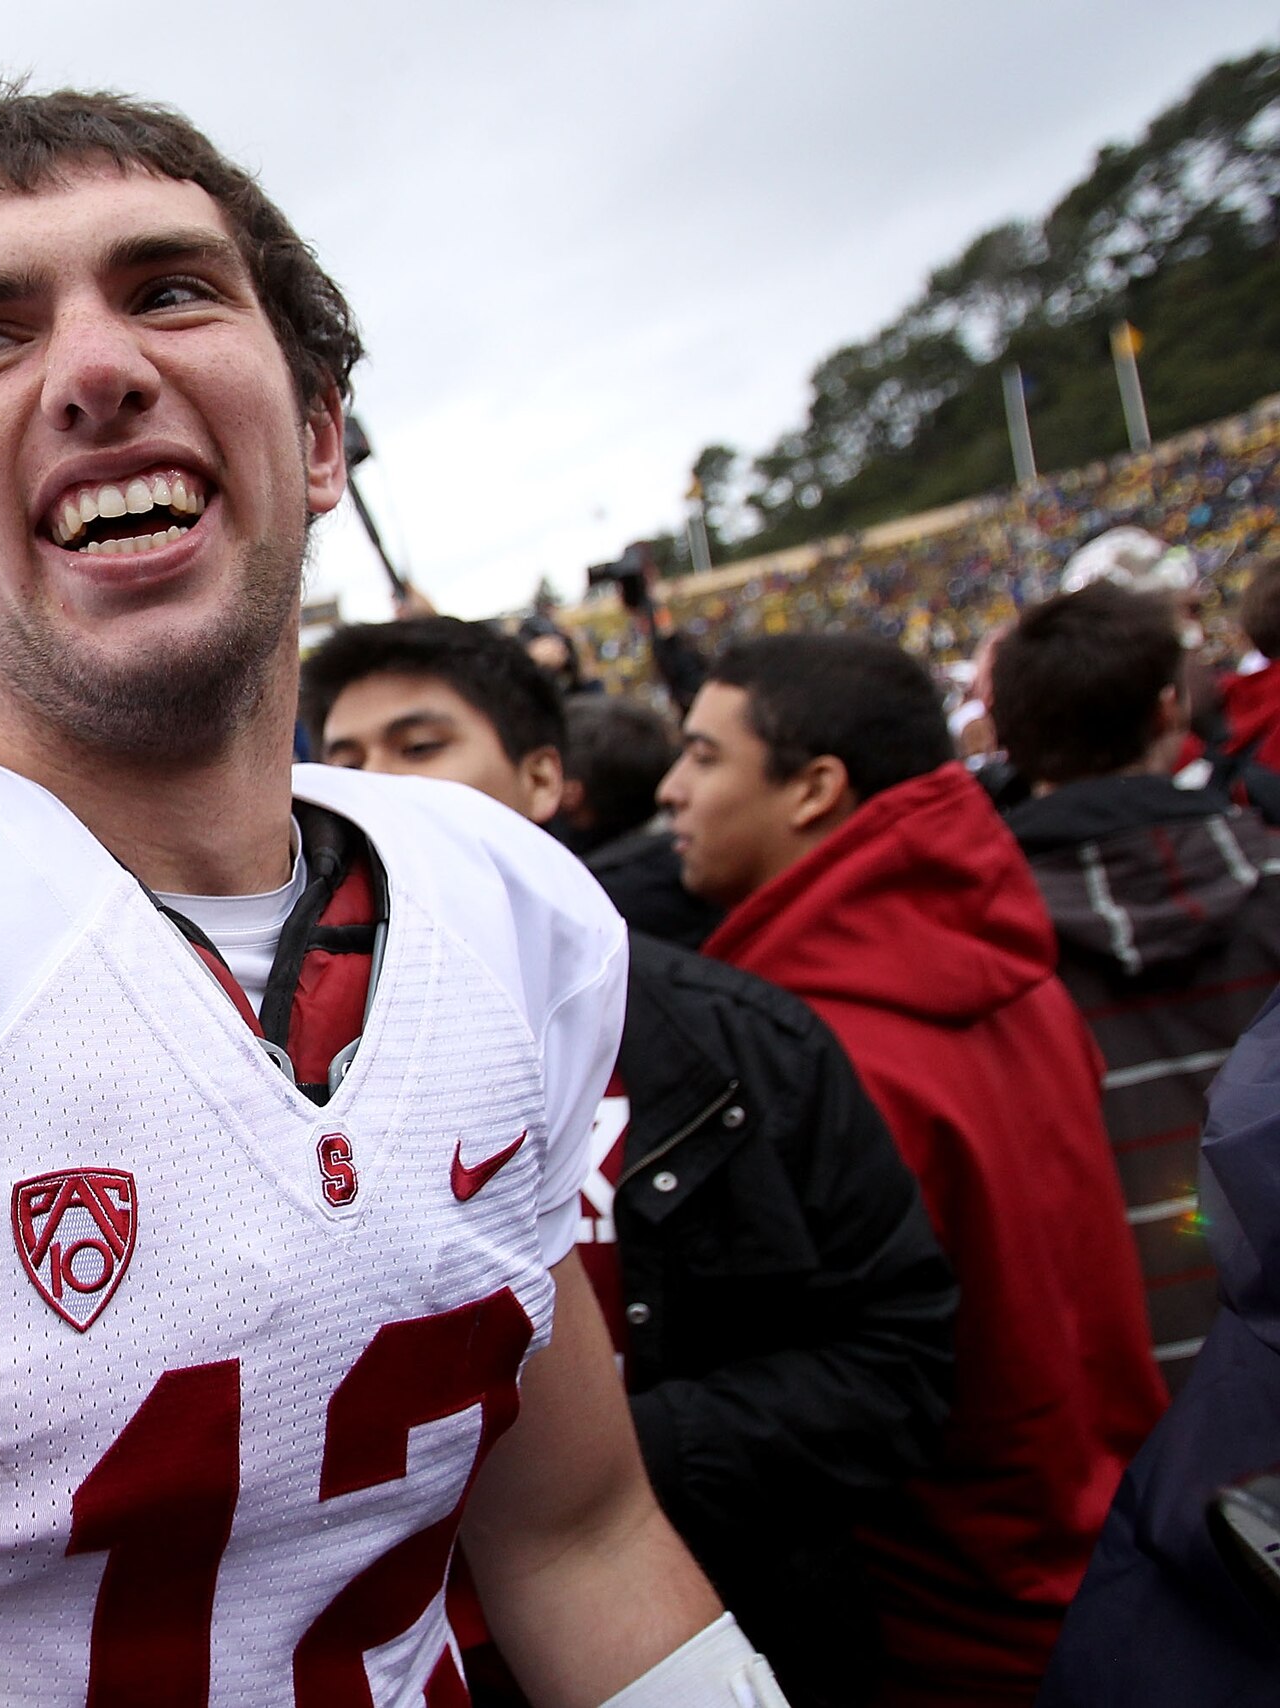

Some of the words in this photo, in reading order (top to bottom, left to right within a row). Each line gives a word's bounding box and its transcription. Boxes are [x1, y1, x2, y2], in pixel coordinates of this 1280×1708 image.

[317, 1132, 358, 1208] S
[19, 1175, 133, 1270] PAC
[49, 1238, 115, 1299] 10
[65, 1286, 535, 1708] 12
